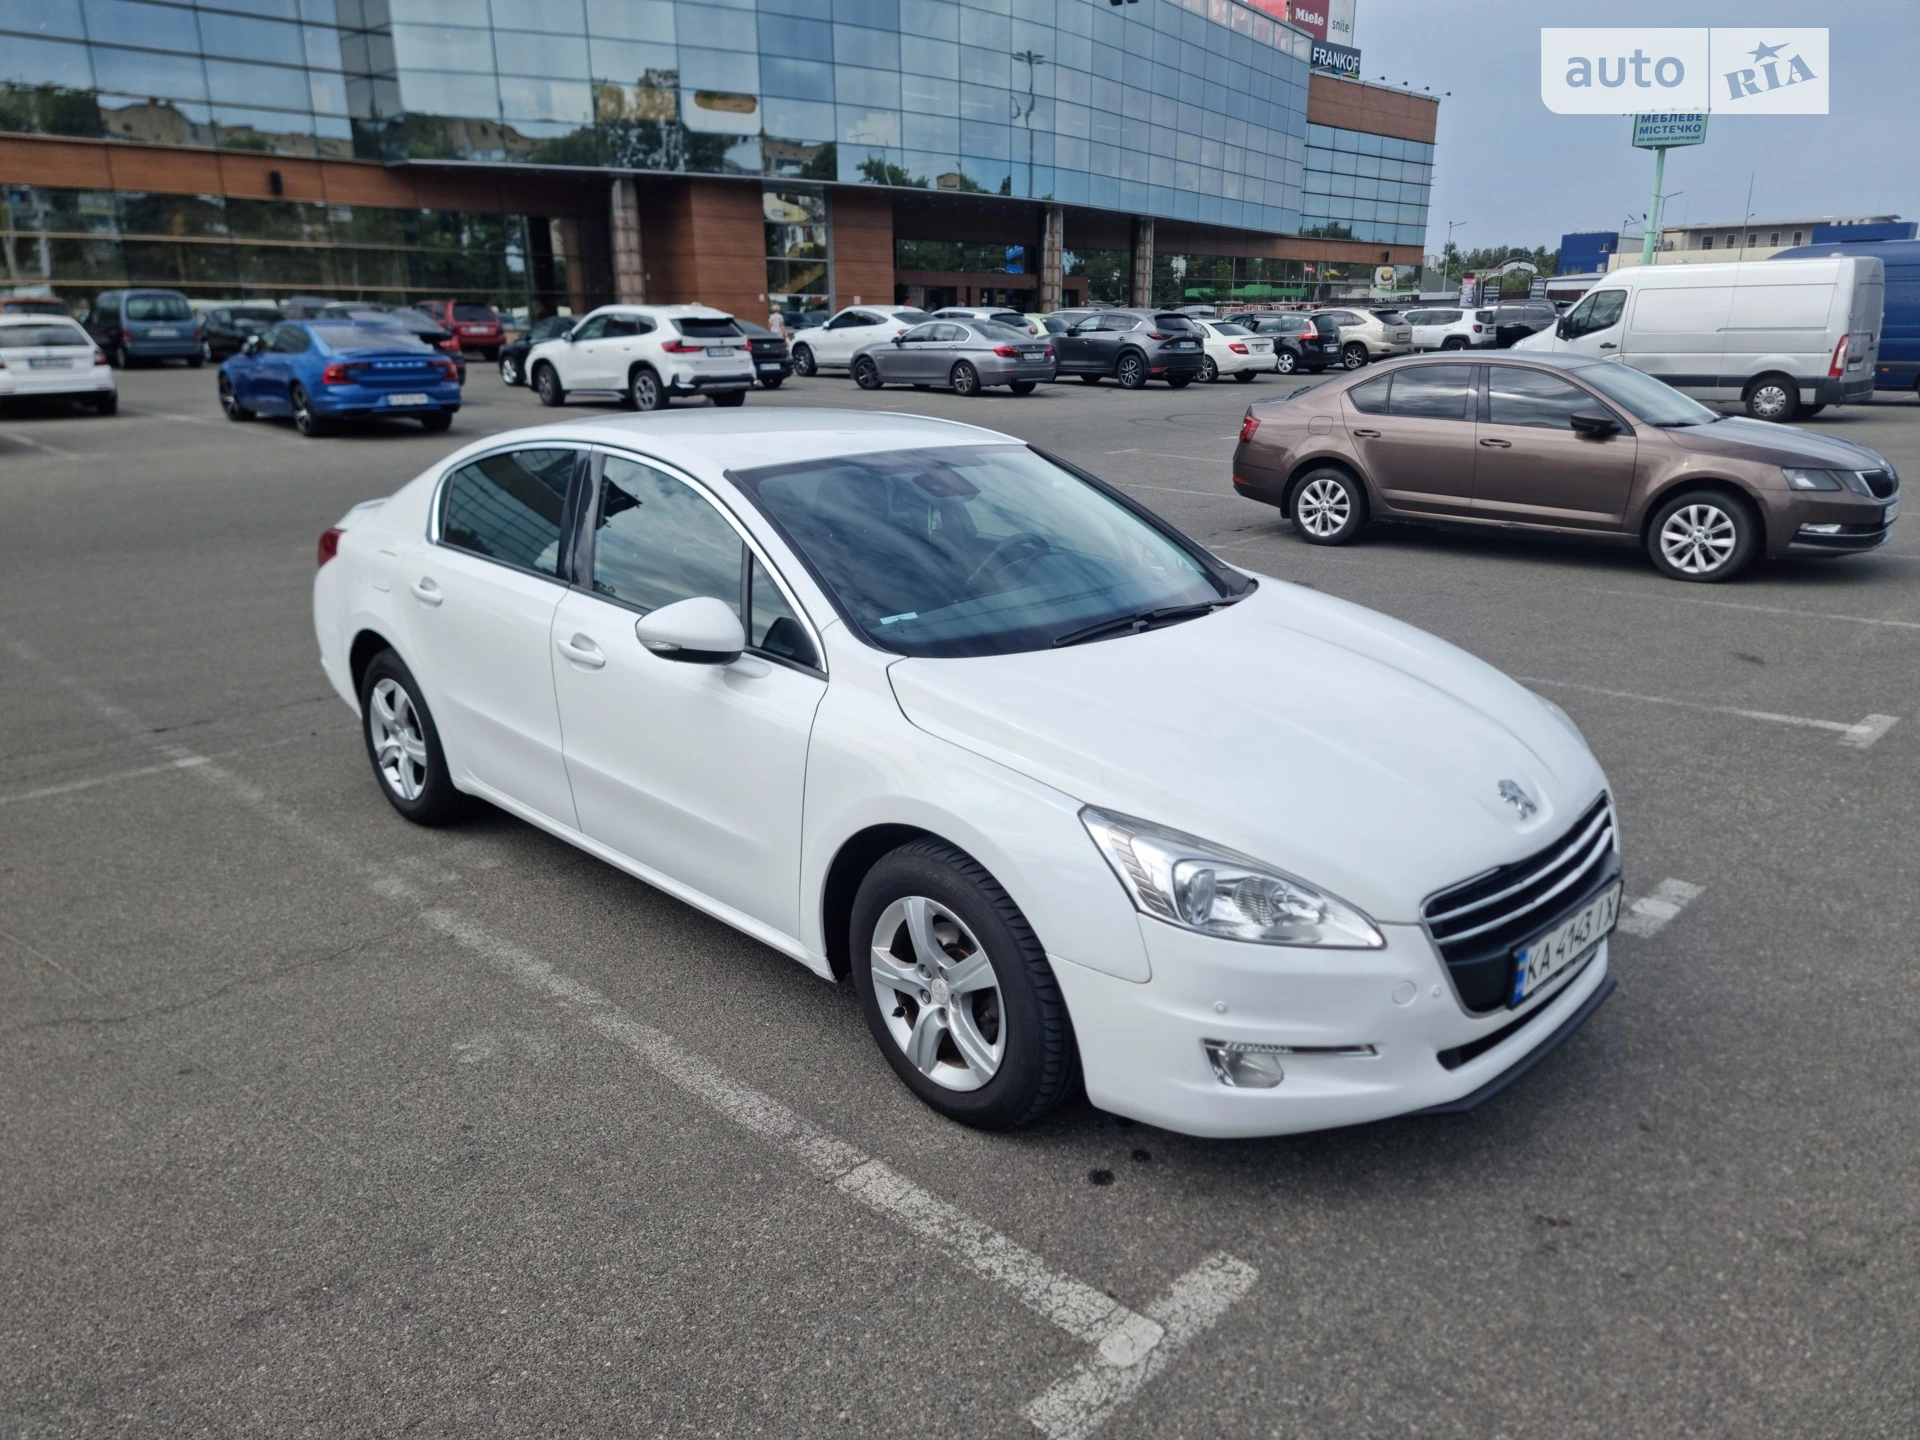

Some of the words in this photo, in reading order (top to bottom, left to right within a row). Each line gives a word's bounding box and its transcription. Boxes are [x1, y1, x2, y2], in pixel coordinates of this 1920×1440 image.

[1295, 8, 1324, 26] Miele
[1313, 47, 1359, 71] FRANKOF
[1641, 113, 1703, 123] МЕБЛЕВЕ
[1640, 124, 1702, 134] МІСТЕЧКО
[1527, 941, 1550, 986] KA
[1556, 909, 1593, 959] 4143
